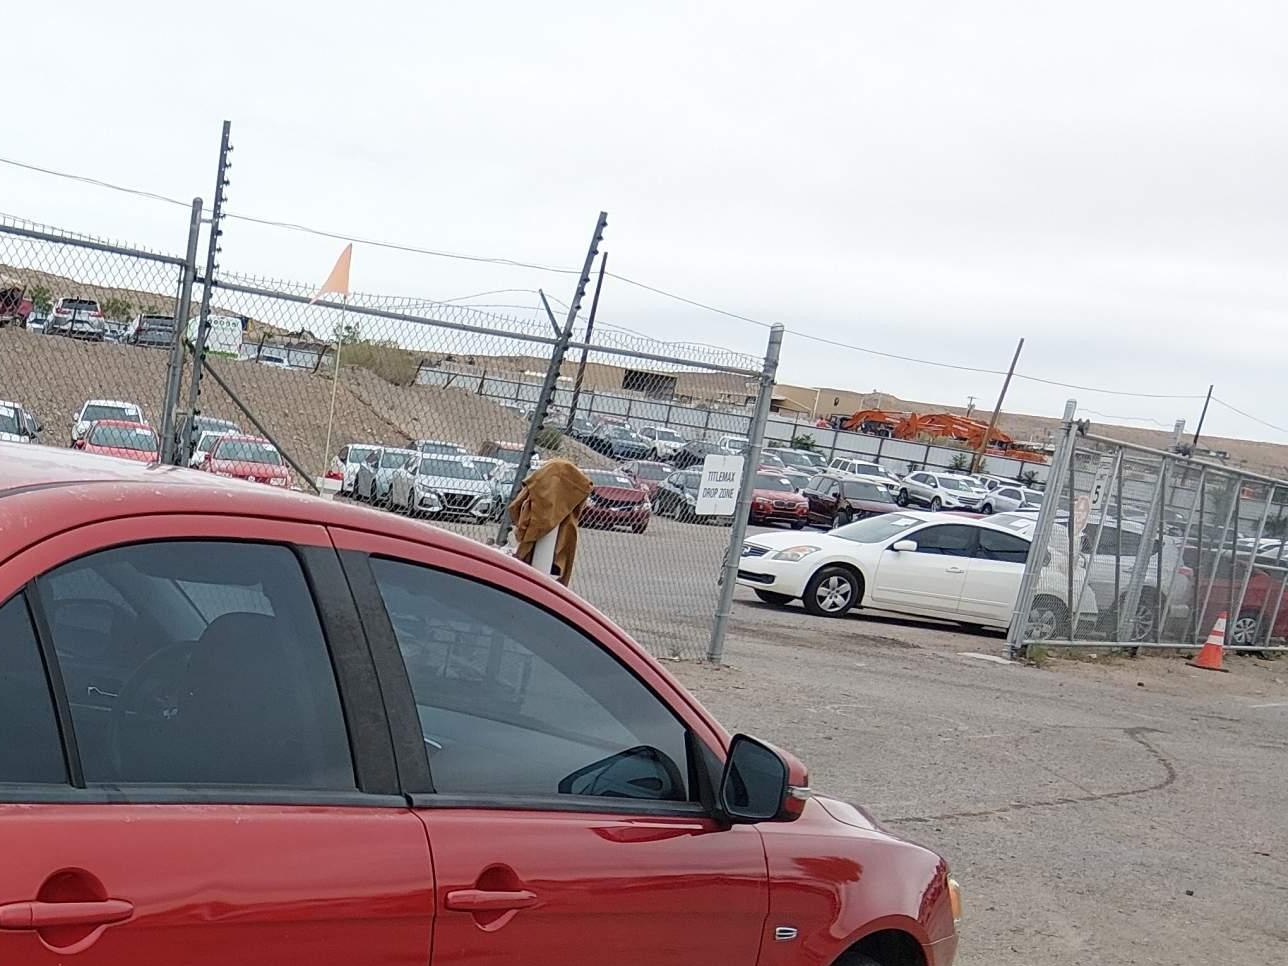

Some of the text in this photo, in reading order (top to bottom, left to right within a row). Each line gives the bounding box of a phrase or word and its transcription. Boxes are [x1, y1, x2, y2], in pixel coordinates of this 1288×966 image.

[707, 471, 737, 483] TITLEMAX
[702, 487, 735, 499] DROP ZONE
[1091, 485, 1102, 504] 5
